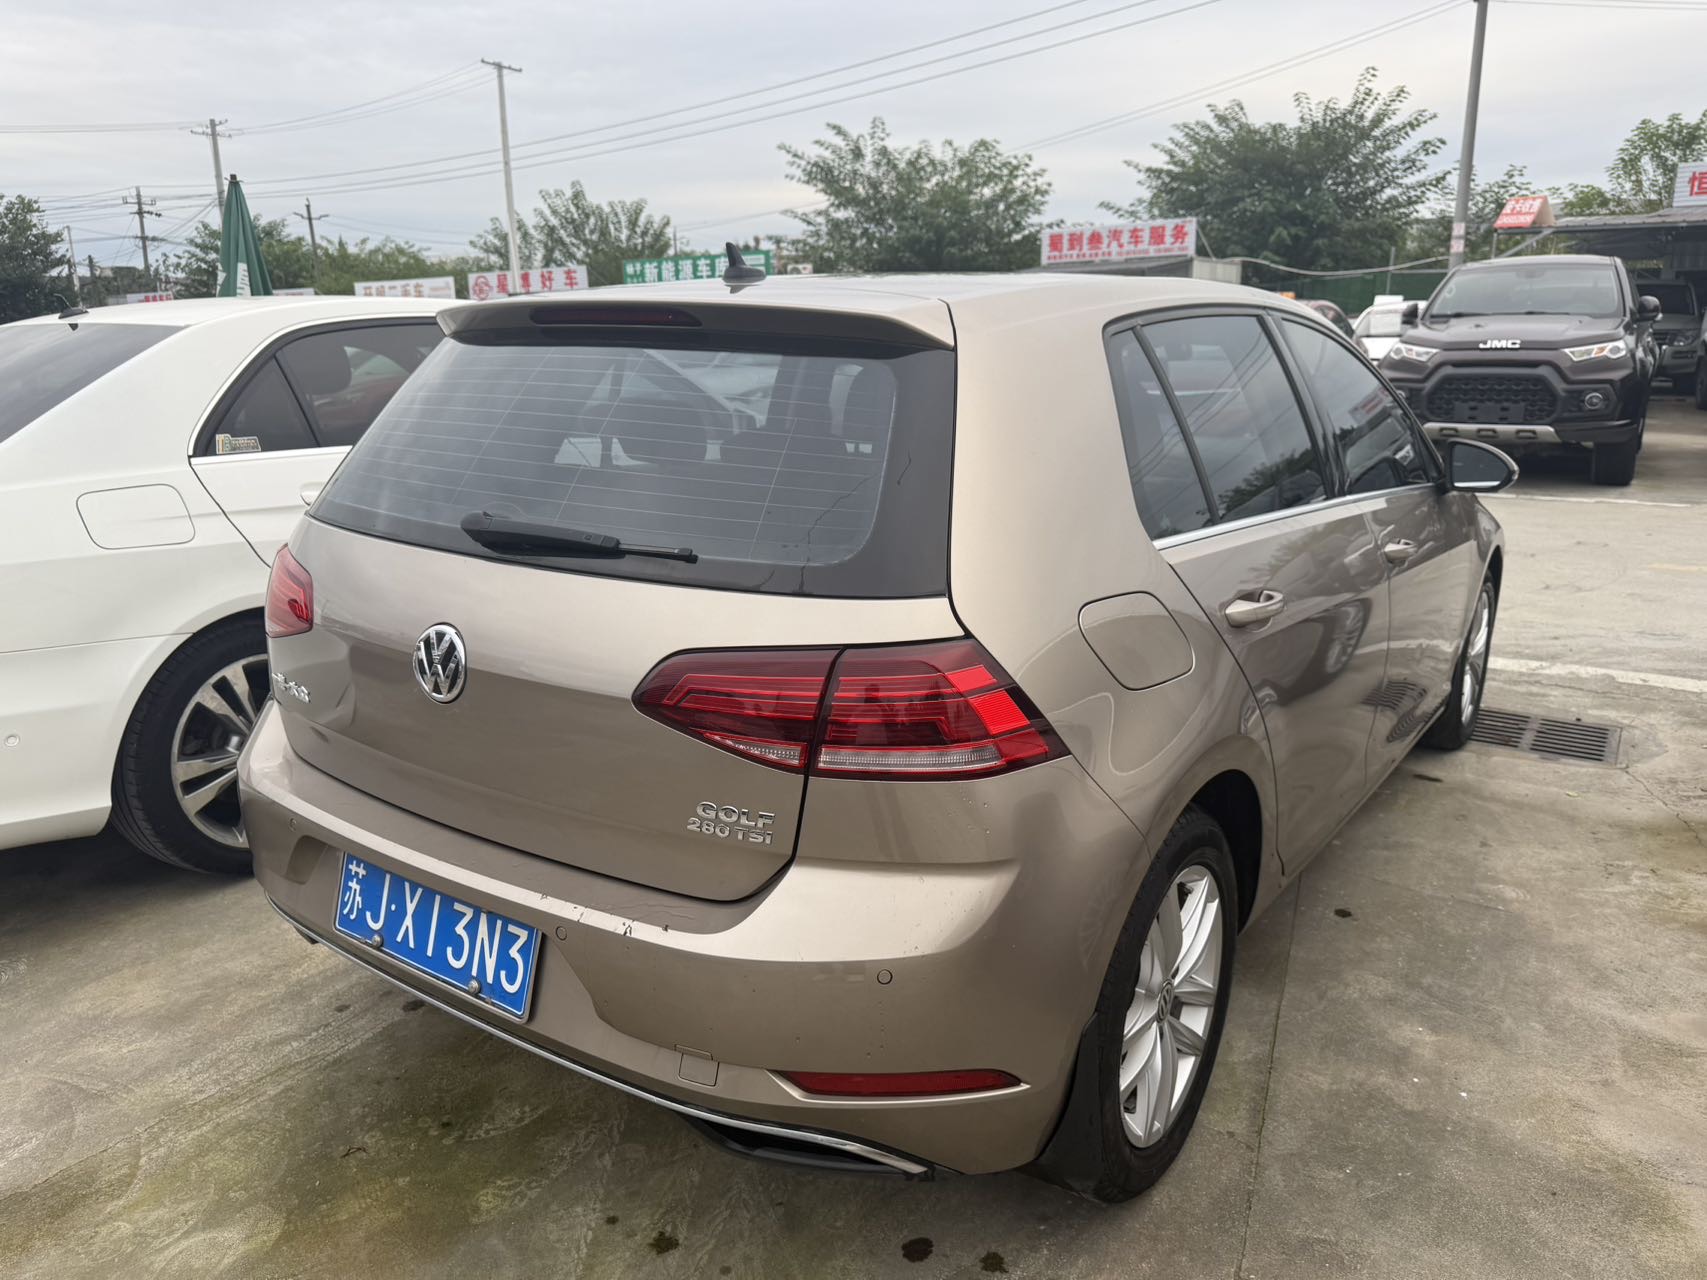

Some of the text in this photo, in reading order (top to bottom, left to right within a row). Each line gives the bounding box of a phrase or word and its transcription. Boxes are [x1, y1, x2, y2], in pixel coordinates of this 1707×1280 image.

[1478, 339, 1521, 349] JMC
[696, 801, 775, 828] GOLF
[686, 817, 730, 838] 280
